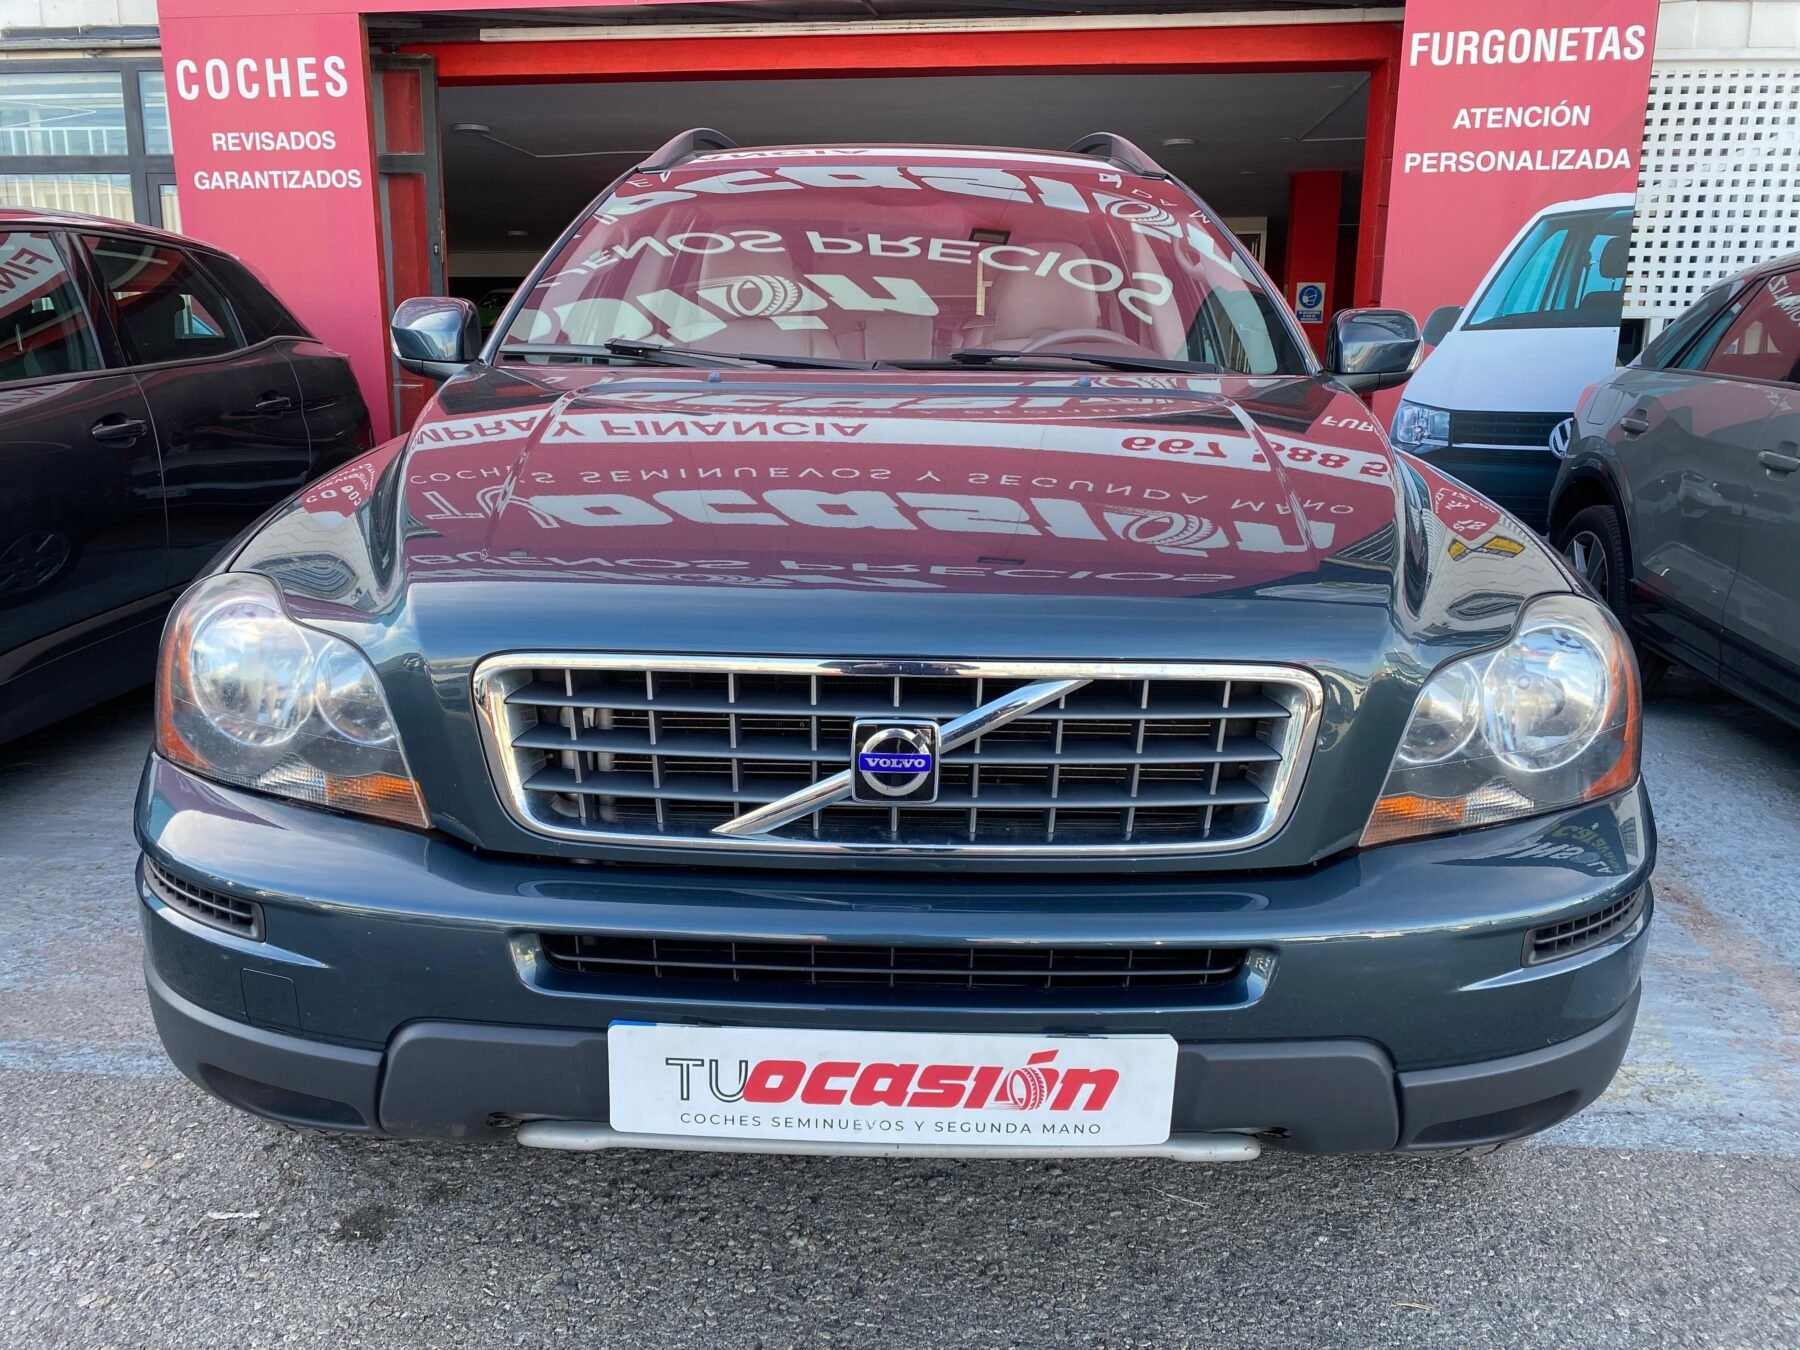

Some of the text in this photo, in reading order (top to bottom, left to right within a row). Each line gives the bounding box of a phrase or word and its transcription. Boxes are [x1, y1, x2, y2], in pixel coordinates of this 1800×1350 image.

[1409, 25, 1646, 66] FURGONETAS
[175, 55, 349, 101] COCHES
[1452, 100, 1591, 130] ATENCIÓN
[211, 130, 336, 152] REVISADOS
[1404, 148, 1632, 174] PERSONALIZADA
[193, 169, 363, 191] GARANTIZADOS
[864, 757, 926, 768] VOLVO
[679, 1112, 1102, 1135] COCHES SEMINUEVOS Y SEGUNDA MANO
